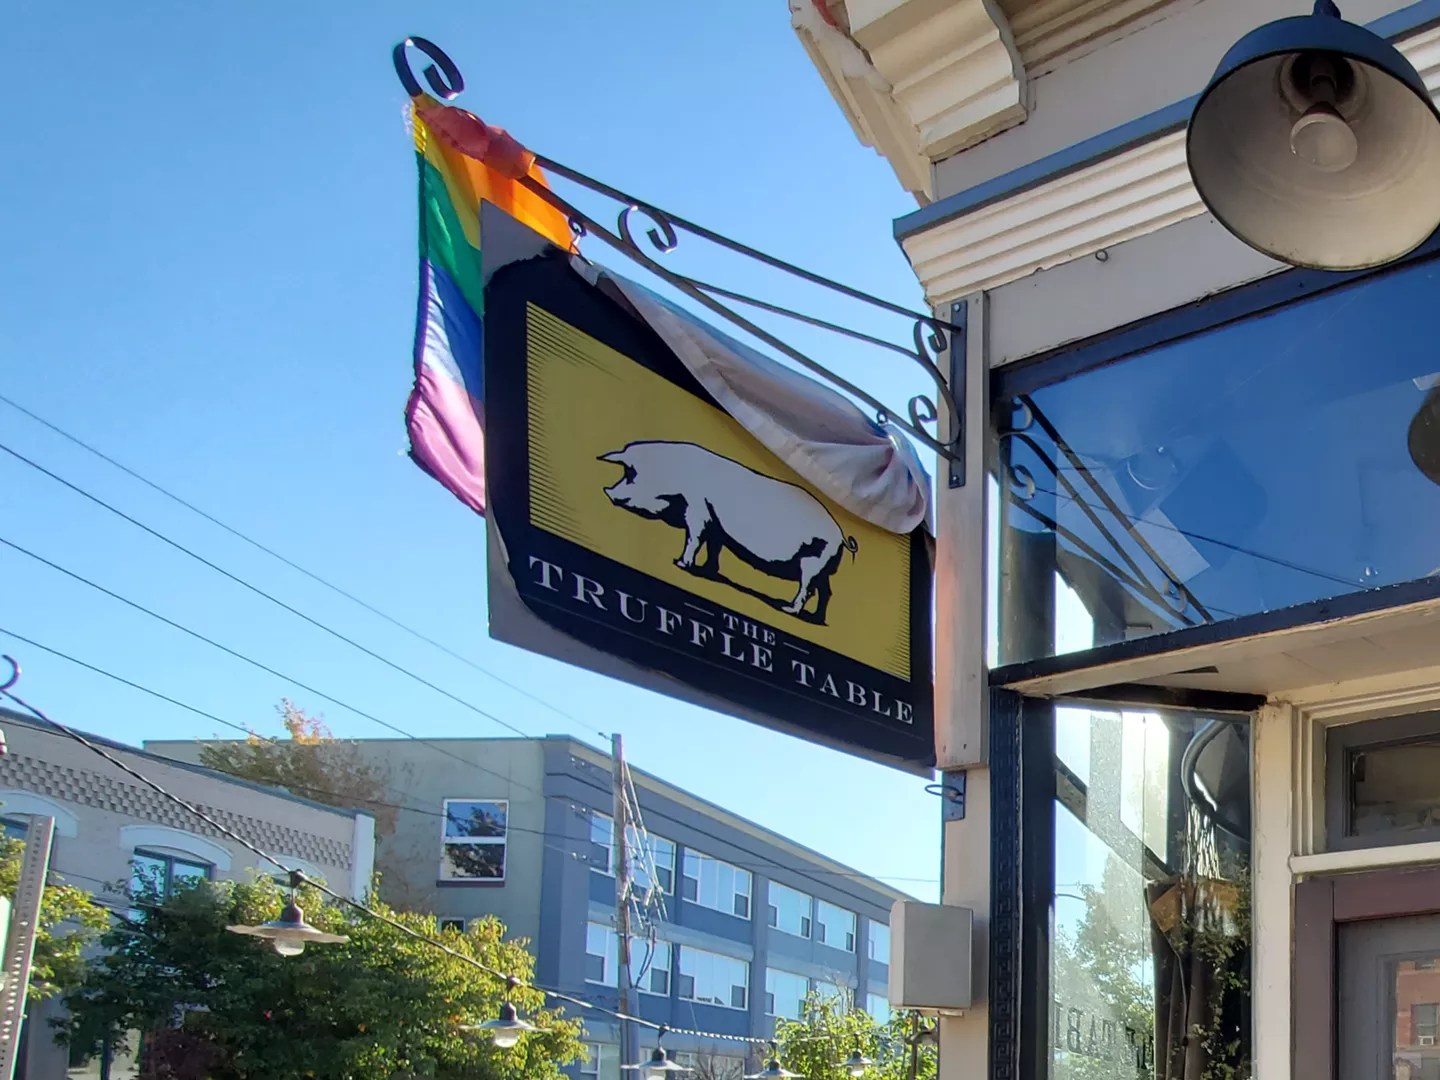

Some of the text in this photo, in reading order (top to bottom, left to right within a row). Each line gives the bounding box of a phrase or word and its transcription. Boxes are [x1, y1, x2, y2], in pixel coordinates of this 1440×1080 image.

[529, 554, 914, 725] TRUFFLE TABLE
[722, 612, 776, 647] THE
